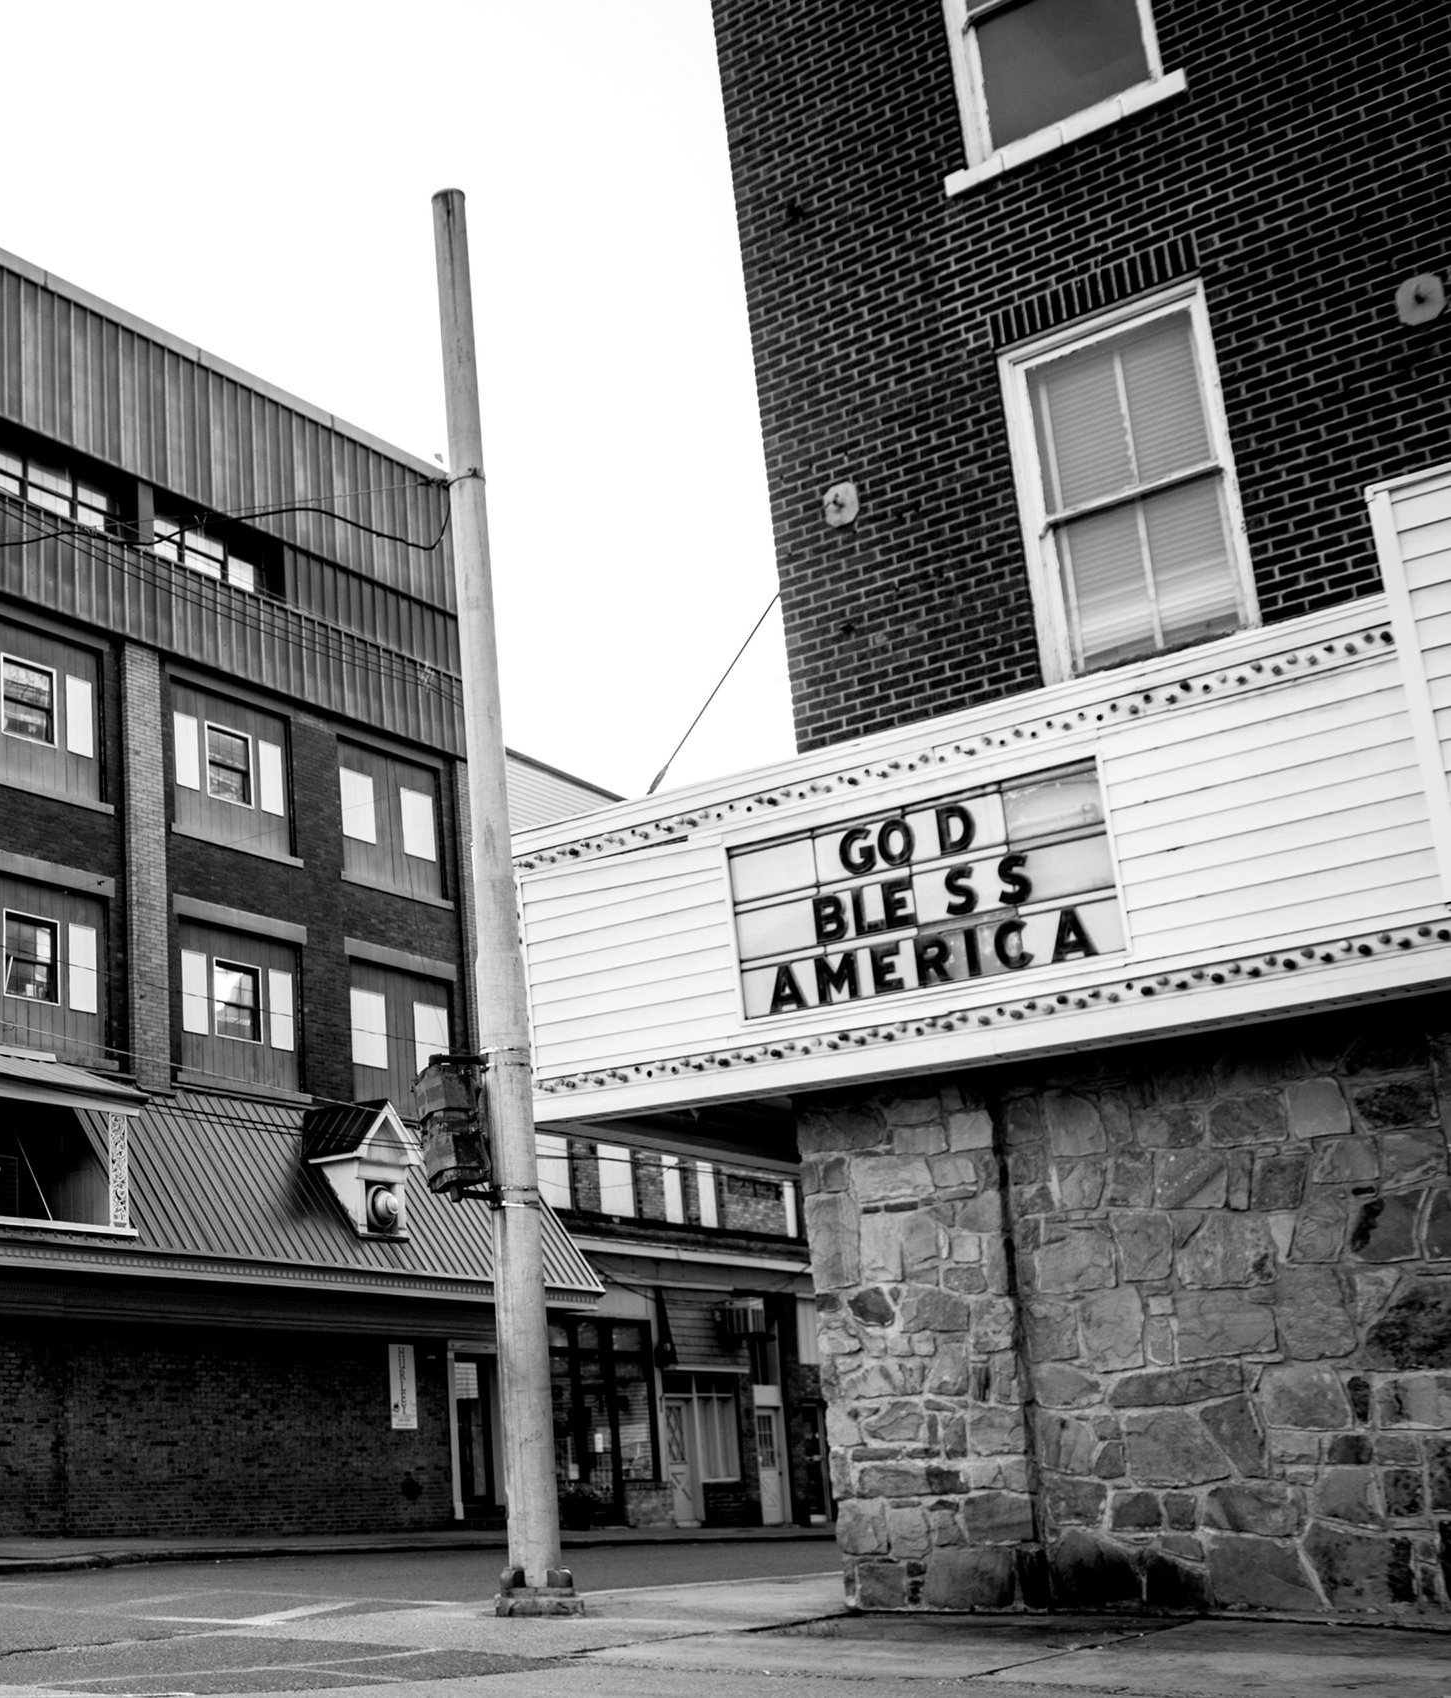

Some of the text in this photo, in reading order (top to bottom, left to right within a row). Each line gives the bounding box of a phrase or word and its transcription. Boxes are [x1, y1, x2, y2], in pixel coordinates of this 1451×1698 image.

[839, 803, 976, 875] GOD
[812, 852, 1033, 945] BLESS
[769, 906, 1099, 1014] AMERICA
[398, 1346, 407, 1414] HURLEY
